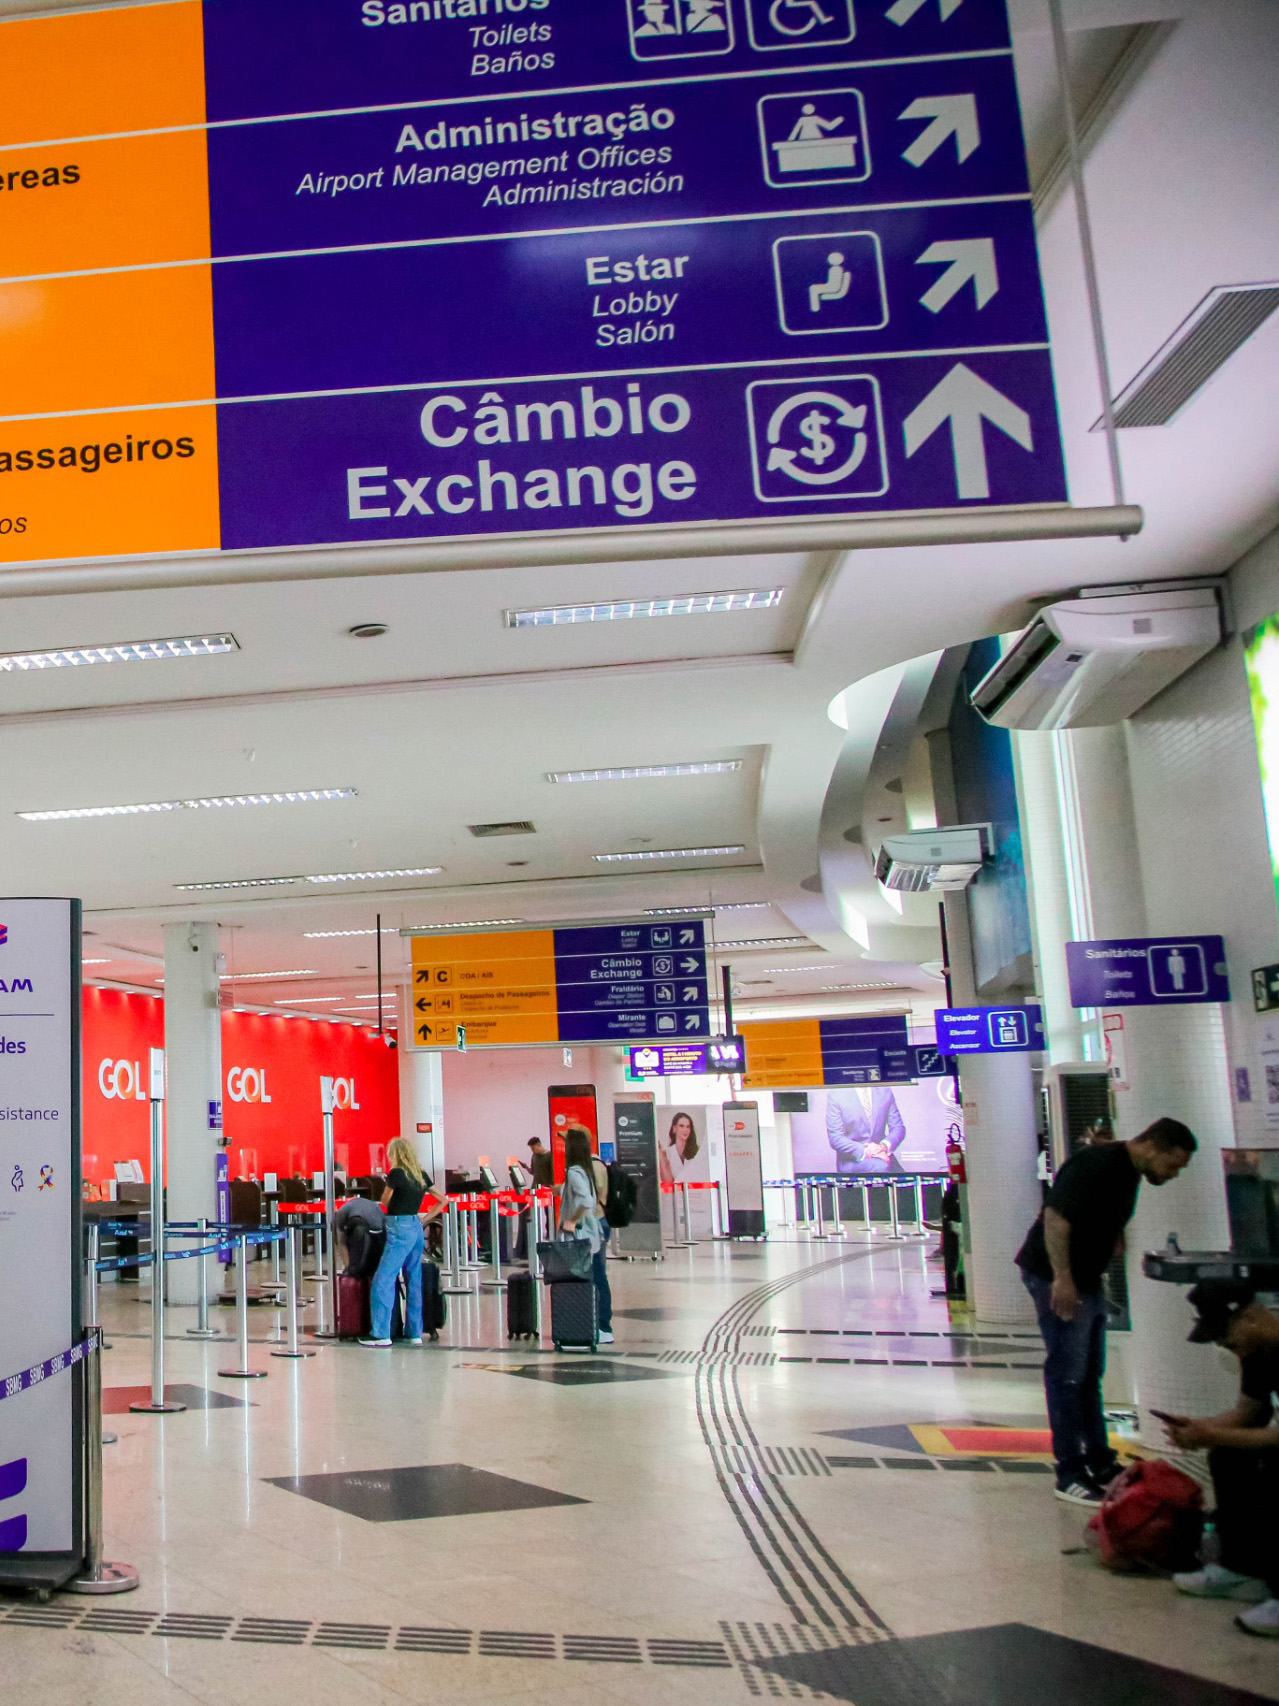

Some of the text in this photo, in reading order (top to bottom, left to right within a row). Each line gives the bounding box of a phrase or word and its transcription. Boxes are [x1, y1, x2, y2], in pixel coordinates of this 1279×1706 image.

[468, 22, 552, 48] Toilets
[470, 50, 556, 76] Baños
[394, 104, 676, 154] Administração
[295, 145, 673, 197] Airport Management Offices
[482, 171, 684, 208] Administración
[586, 253, 690, 286] Estar
[592, 290, 679, 318] Lobby
[595, 320, 675, 347] Salón
[420, 382, 691, 449] Câmbio
[347, 456, 697, 520] Exchange
[620, 929, 640, 937] Estar
[601, 958, 642, 968] Câmbio
[1086, 948, 1147, 959] Sanitários
[590, 969, 643, 979] Exchange
[1103, 970, 1133, 979] Toilets
[943, 1014, 980, 1022] Elevador
[98, 1057, 146, 1101] GOL
[226, 1066, 271, 1103] GOL
[50, 1353, 65, 1375] SBMG
[70, 1343, 83, 1365] SBMG
[5, 1374, 22, 1397] SBMG
[29, 1364, 45, 1385] SBMG
